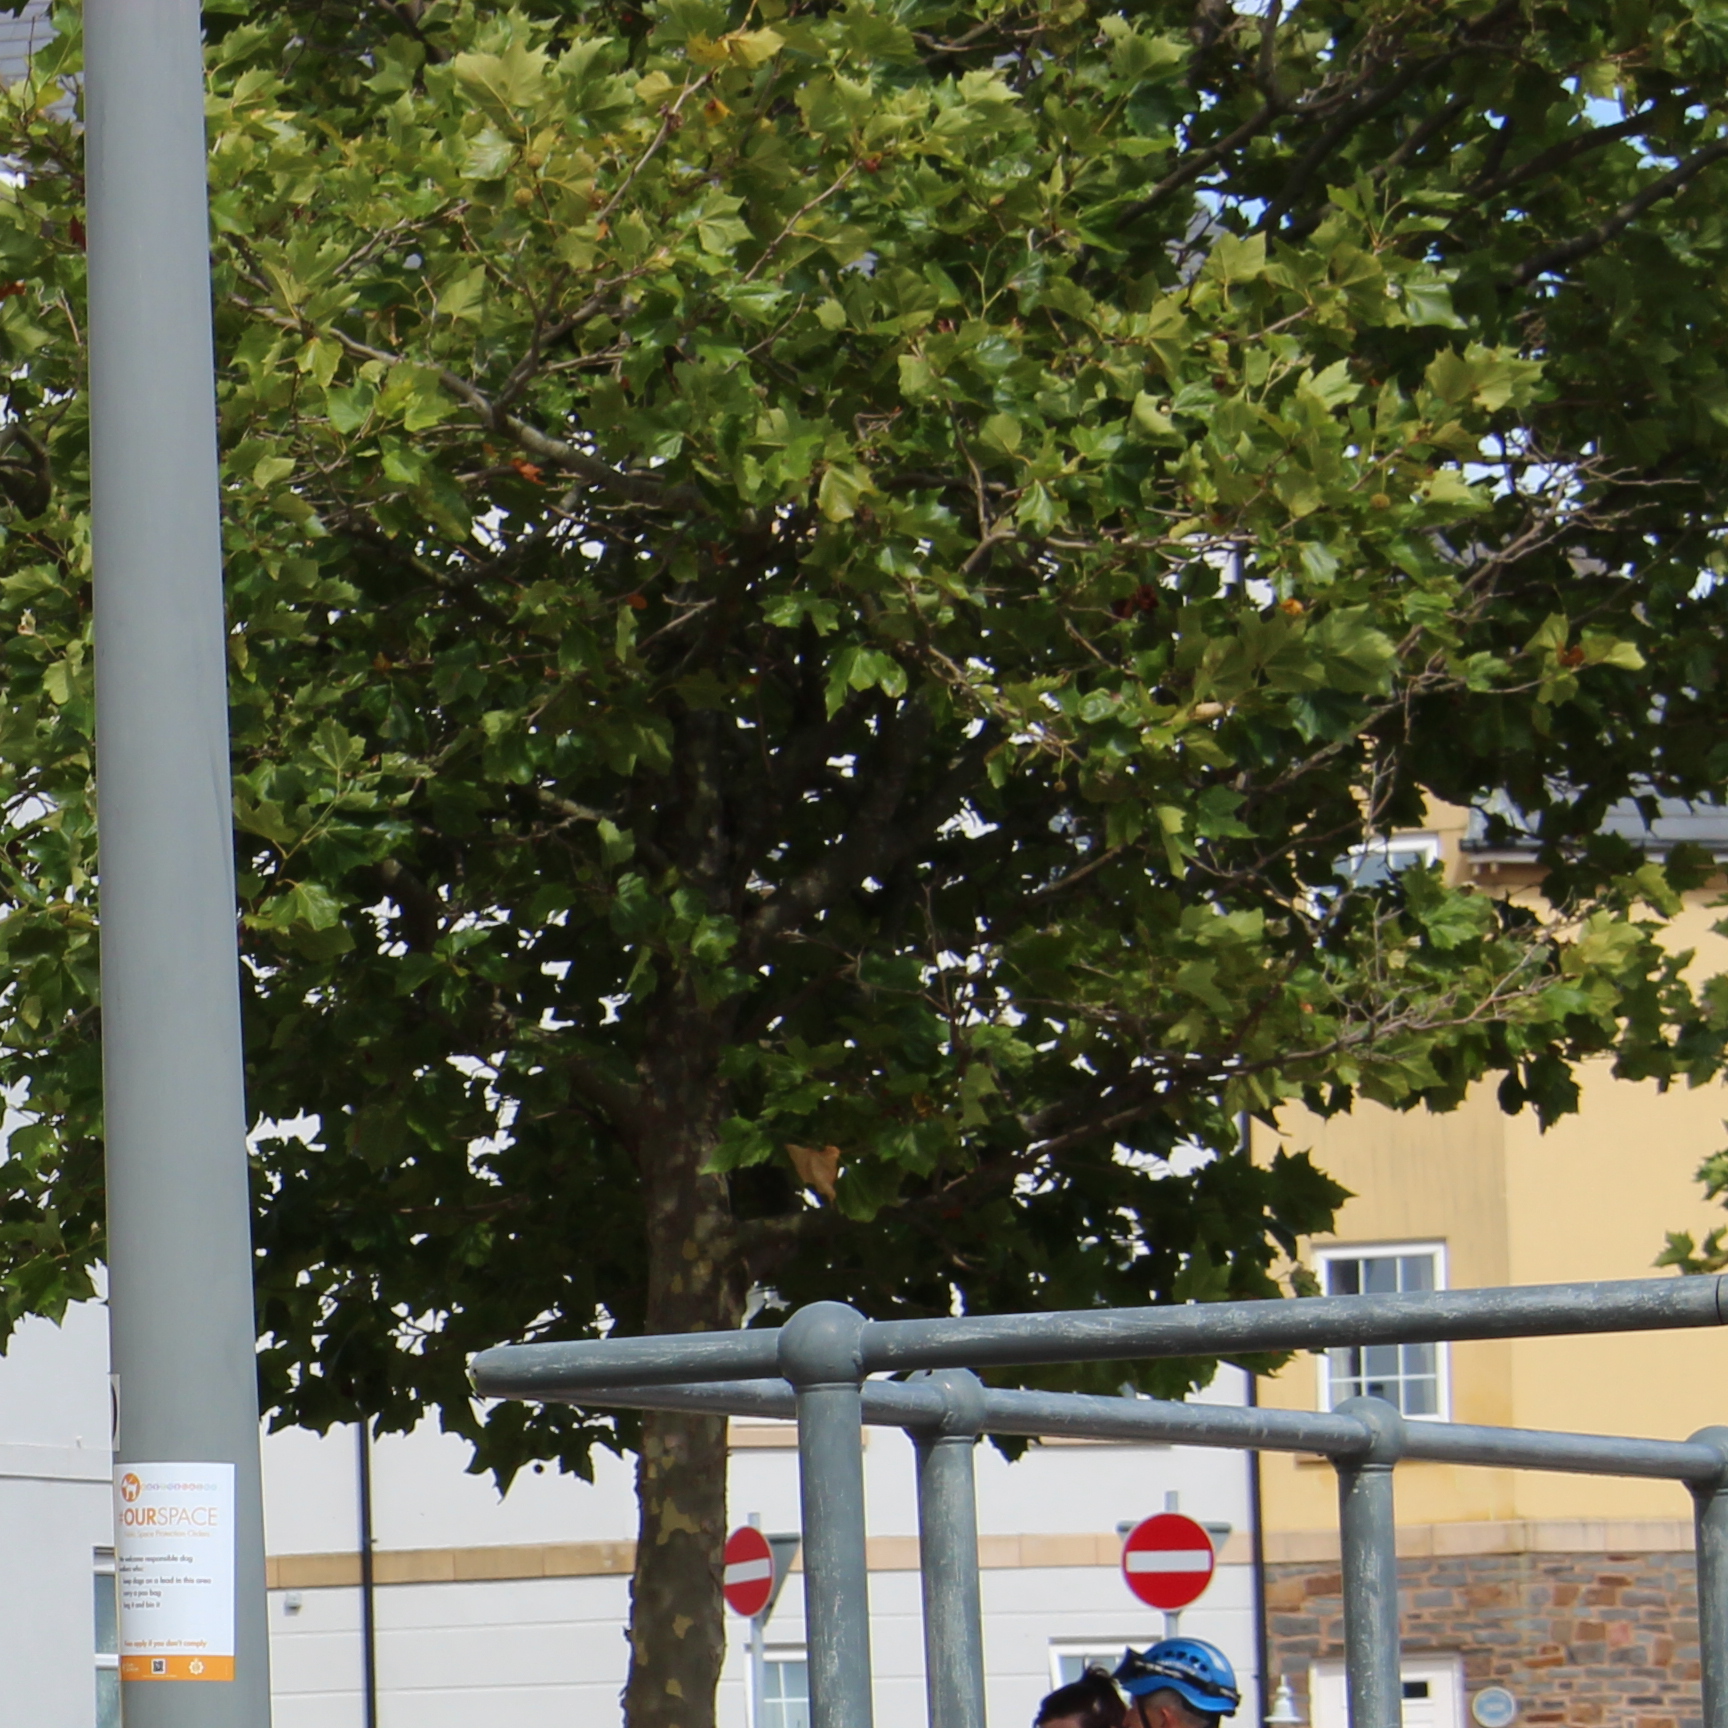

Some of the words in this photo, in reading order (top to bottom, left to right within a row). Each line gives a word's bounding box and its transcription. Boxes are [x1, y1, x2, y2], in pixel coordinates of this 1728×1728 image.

[145, 1555, 178, 1563] responsible
[180, 1555, 193, 1563] dog
[160, 1576, 174, 1584] lead
[183, 1576, 194, 1584] this
[149, 1588, 162, 1597] bag
[165, 1639, 183, 1647] don't
[183, 1639, 207, 1648] comply
